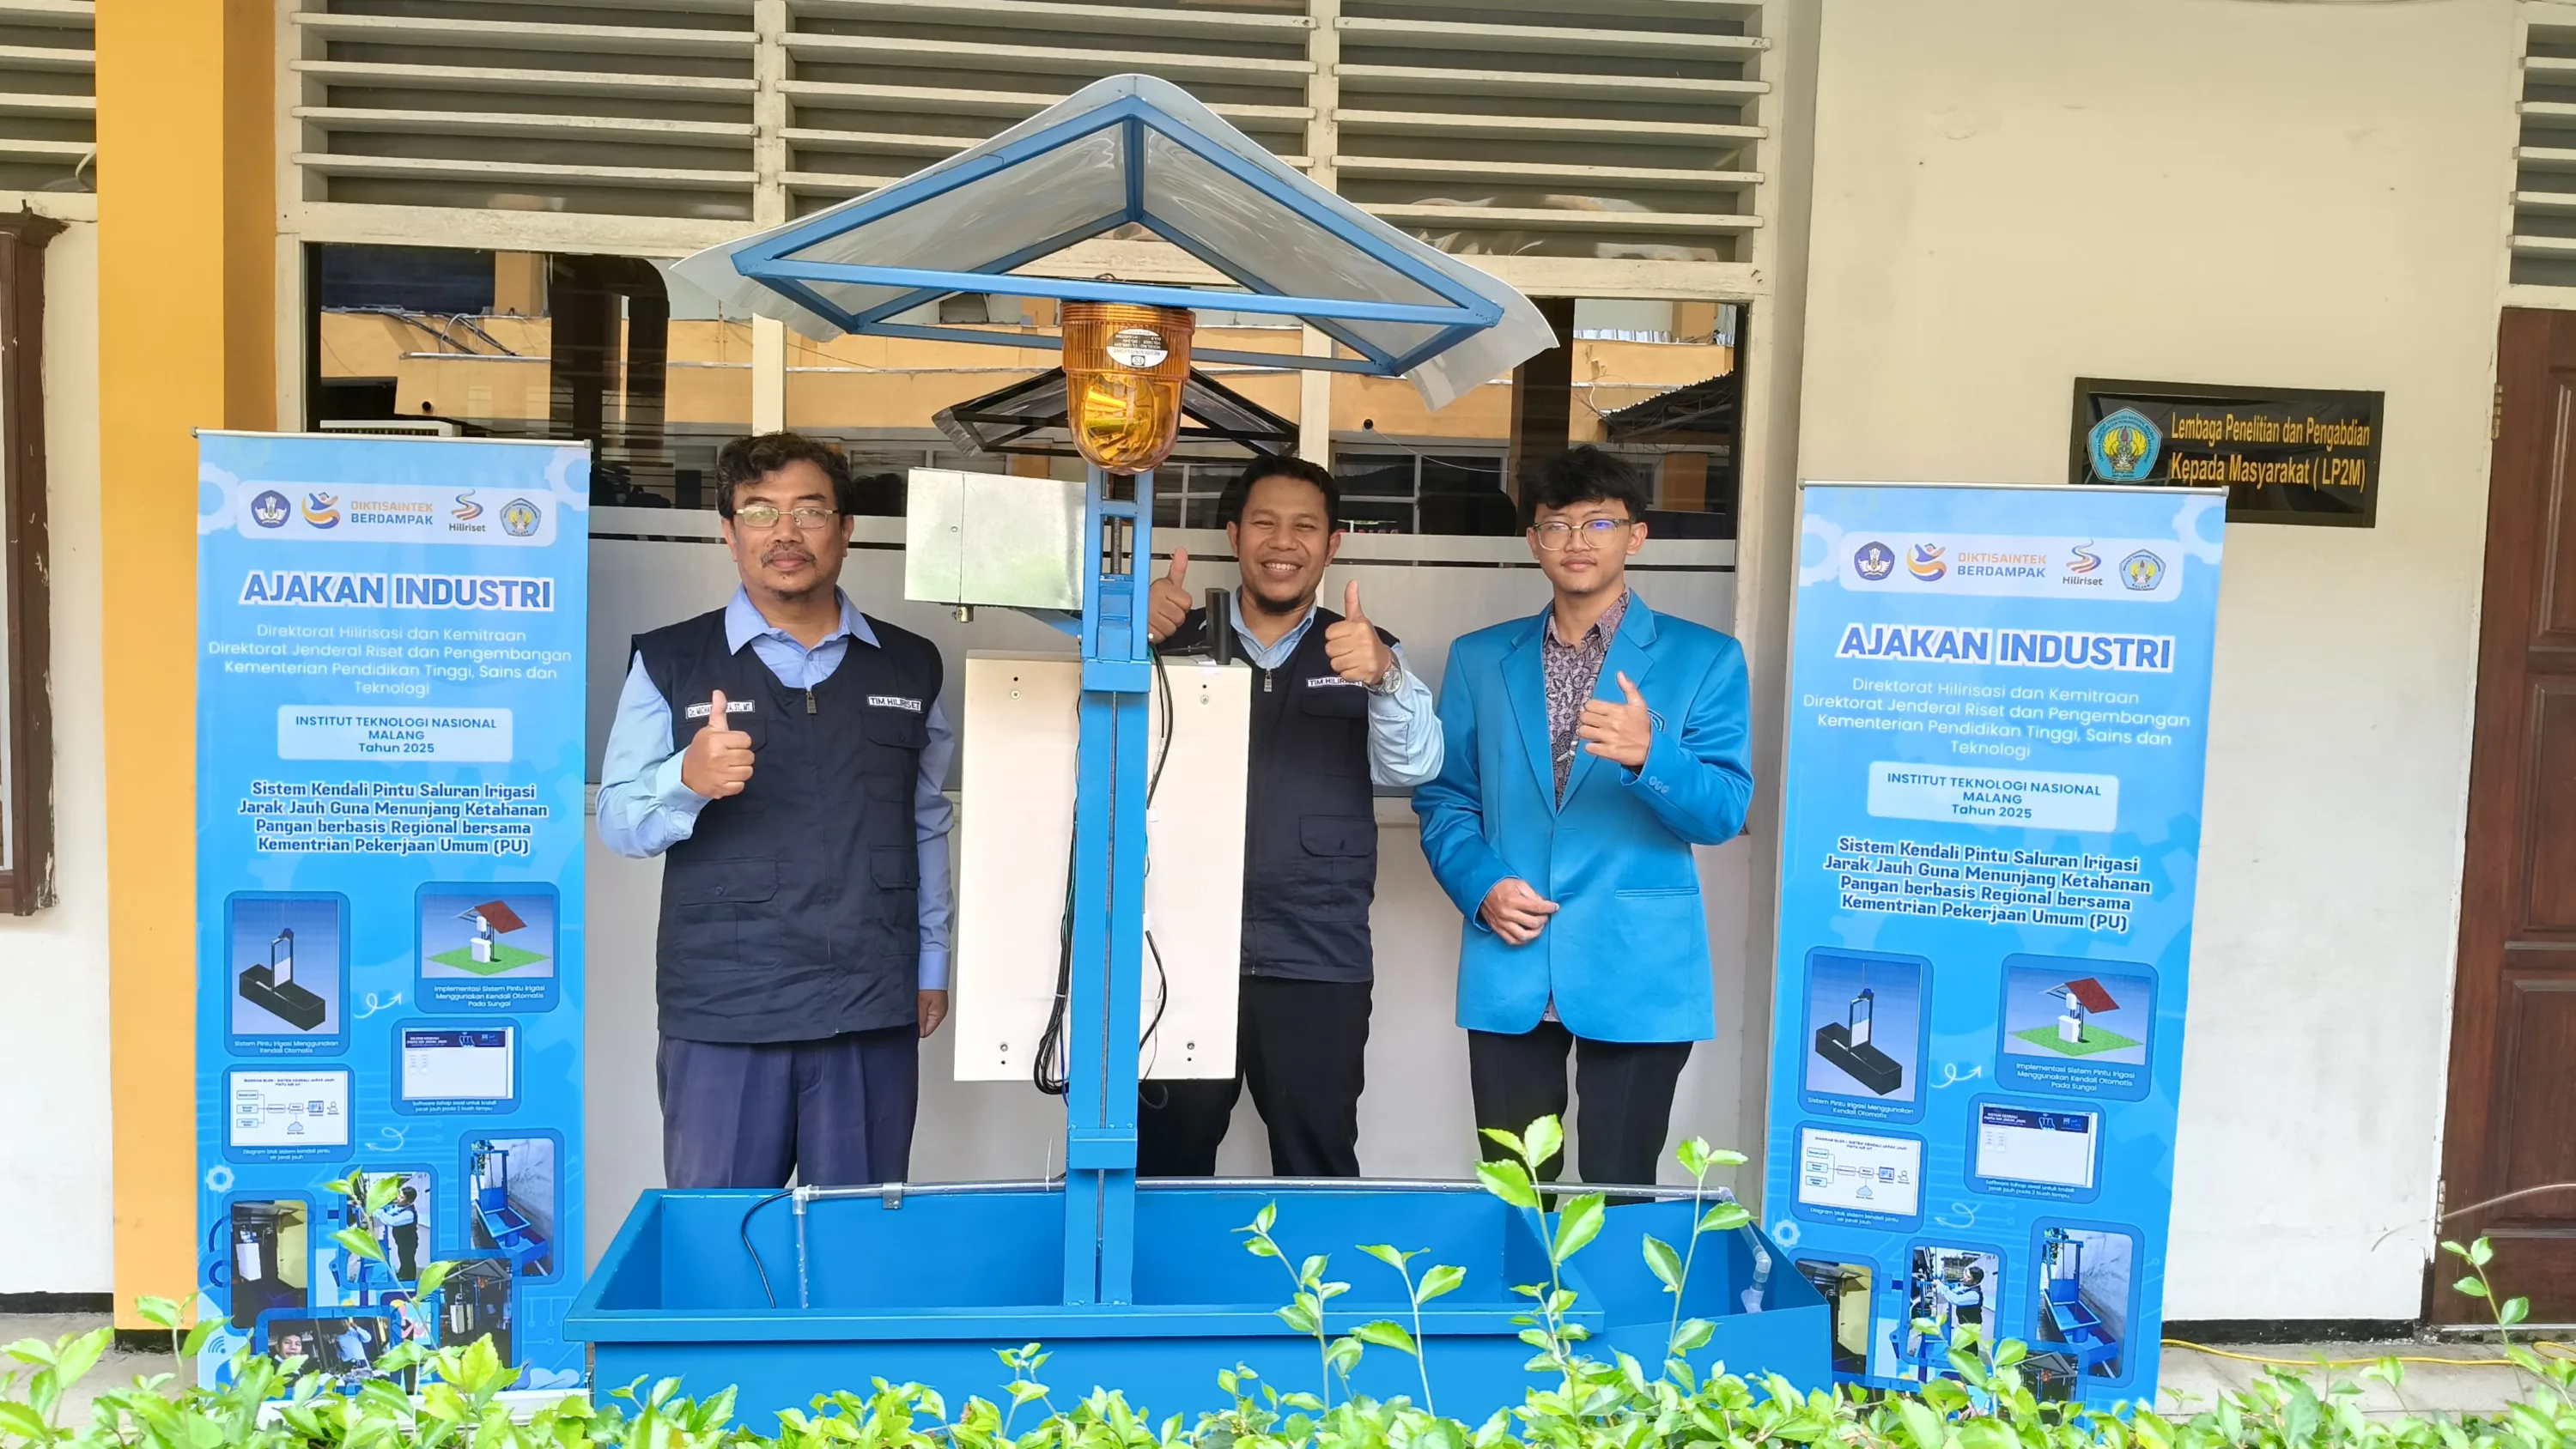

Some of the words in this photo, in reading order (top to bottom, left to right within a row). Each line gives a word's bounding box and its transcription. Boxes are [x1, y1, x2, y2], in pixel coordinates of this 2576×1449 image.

[2172, 412, 2221, 447] Lembaga
[2226, 414, 2279, 443] Penelitian
[2282, 416, 2303, 443] dan
[2306, 417, 2369, 452] Pengabdian
[2171, 452, 2224, 486] Kepada
[2229, 454, 2309, 489] Masyarakat
[2313, 458, 2318, 491] (
[2323, 458, 2366, 493] LP2M)
[350, 500, 433, 513] DIKTISAINTEK
[350, 514, 433, 525] BERDAMPAK
[1958, 552, 2046, 566] DIKTISAINTEK
[1957, 565, 2045, 578] BERDAMPAK
[2062, 576, 2103, 586] Hiliriset
[243, 573, 385, 604] AJAKAN
[395, 576, 551, 609] INDUSTRI
[258, 624, 334, 638] Direktorat
[339, 627, 403, 640] Hilirisasi
[407, 627, 440, 640] dan
[444, 628, 526, 641] Kemitraan
[209, 642, 287, 655] Direktorat
[293, 645, 361, 657] Jenderal
[366, 646, 403, 658] Riset
[407, 646, 440, 658] dan
[444, 646, 571, 664] Pengembangan
[1840, 626, 1988, 660] AJAKAN
[1999, 632, 2171, 669] INDUSTRI
[225, 661, 327, 674] Kementerian
[332, 663, 419, 676] Pendidikan
[425, 664, 475, 682] Tinggi,
[479, 665, 522, 678] Sains
[526, 666, 557, 679] dan
[355, 681, 429, 699] Teknologi
[1853, 677, 1932, 694] Direktorat
[1938, 683, 2006, 698] Hilirisasi
[2010, 686, 2044, 700] dan
[2049, 688, 2139, 704] Kemitraan
[1804, 694, 1882, 710] Direktorat
[1888, 700, 1960, 714] Jenderal
[1965, 703, 2004, 717] Riset
[2009, 705, 2044, 718] dan
[2049, 706, 2190, 730] Pengembangan
[296, 716, 353, 726] INSTITUT
[355, 717, 428, 727] TEKNOLOGI
[432, 718, 496, 728] NASIONAL
[1818, 714, 1923, 731] Kementerian
[1929, 720, 2020, 737] Pendidikan
[2026, 725, 2081, 744] Tinggi,
[2087, 728, 2131, 744] Sains
[2136, 731, 2172, 745] dan
[368, 731, 424, 740] MALANG
[359, 743, 400, 753] Tahun
[404, 743, 434, 753] 2025
[1952, 740, 2030, 761] Teknologi
[252, 781, 307, 796] Sistem
[311, 782, 368, 797] Kendali
[374, 784, 414, 797] Pintu
[419, 783, 480, 797] Saluran
[484, 784, 536, 801] Irigasi
[1887, 773, 1947, 786] INSTITUT
[1950, 777, 2026, 791] TEKNOLOGI
[2031, 782, 2101, 796] NASIONAL
[1963, 791, 2022, 804] MALANG
[239, 799, 283, 814] Jarak
[289, 800, 325, 814] Jauh
[330, 801, 370, 815] Guna
[374, 802, 459, 817] Menunjang
[465, 802, 548, 816] Ketahanan
[1952, 803, 1996, 816] Tahun
[1999, 807, 2032, 819] 2025
[256, 818, 313, 835] Pangan
[318, 819, 386, 834] berbasis
[391, 820, 458, 836] Regional
[462, 820, 532, 834] bersama
[258, 837, 349, 852] Kementrian
[355, 838, 434, 853] Pekerjaan
[440, 839, 489, 852] Umum
[493, 839, 529, 855] (PU)
[1838, 837, 1895, 855] Sistem
[1899, 841, 1959, 859] Kendali
[1965, 846, 2007, 863] Pintu
[2013, 850, 2078, 868] Saluran
[2083, 854, 2138, 872] Irigasi
[1824, 855, 1870, 872] Jarak
[1874, 858, 1913, 876] Jauh
[1917, 862, 1960, 879] Guna
[1965, 865, 2055, 888] Menunjang
[2061, 872, 2151, 893] Ketahanan
[1840, 875, 1899, 894] Pangan
[1904, 879, 1976, 900] berbasis
[1982, 887, 2051, 905] Regional
[2057, 891, 2131, 911] bersama
[1841, 894, 1937, 915] Kementrian
[1942, 902, 2026, 922] Pekerjaan
[2032, 909, 2084, 926] Umum
[2089, 913, 2128, 932] (PU)
[2016, 1063, 2066, 1073] Implementasi
[2067, 1066, 2092, 1075] Sistem
[2017, 1070, 2069, 1081] Menggunakan
[2099, 1077, 2133, 1086] Otomatis
[2072, 1082, 2097, 1092] Sungai
